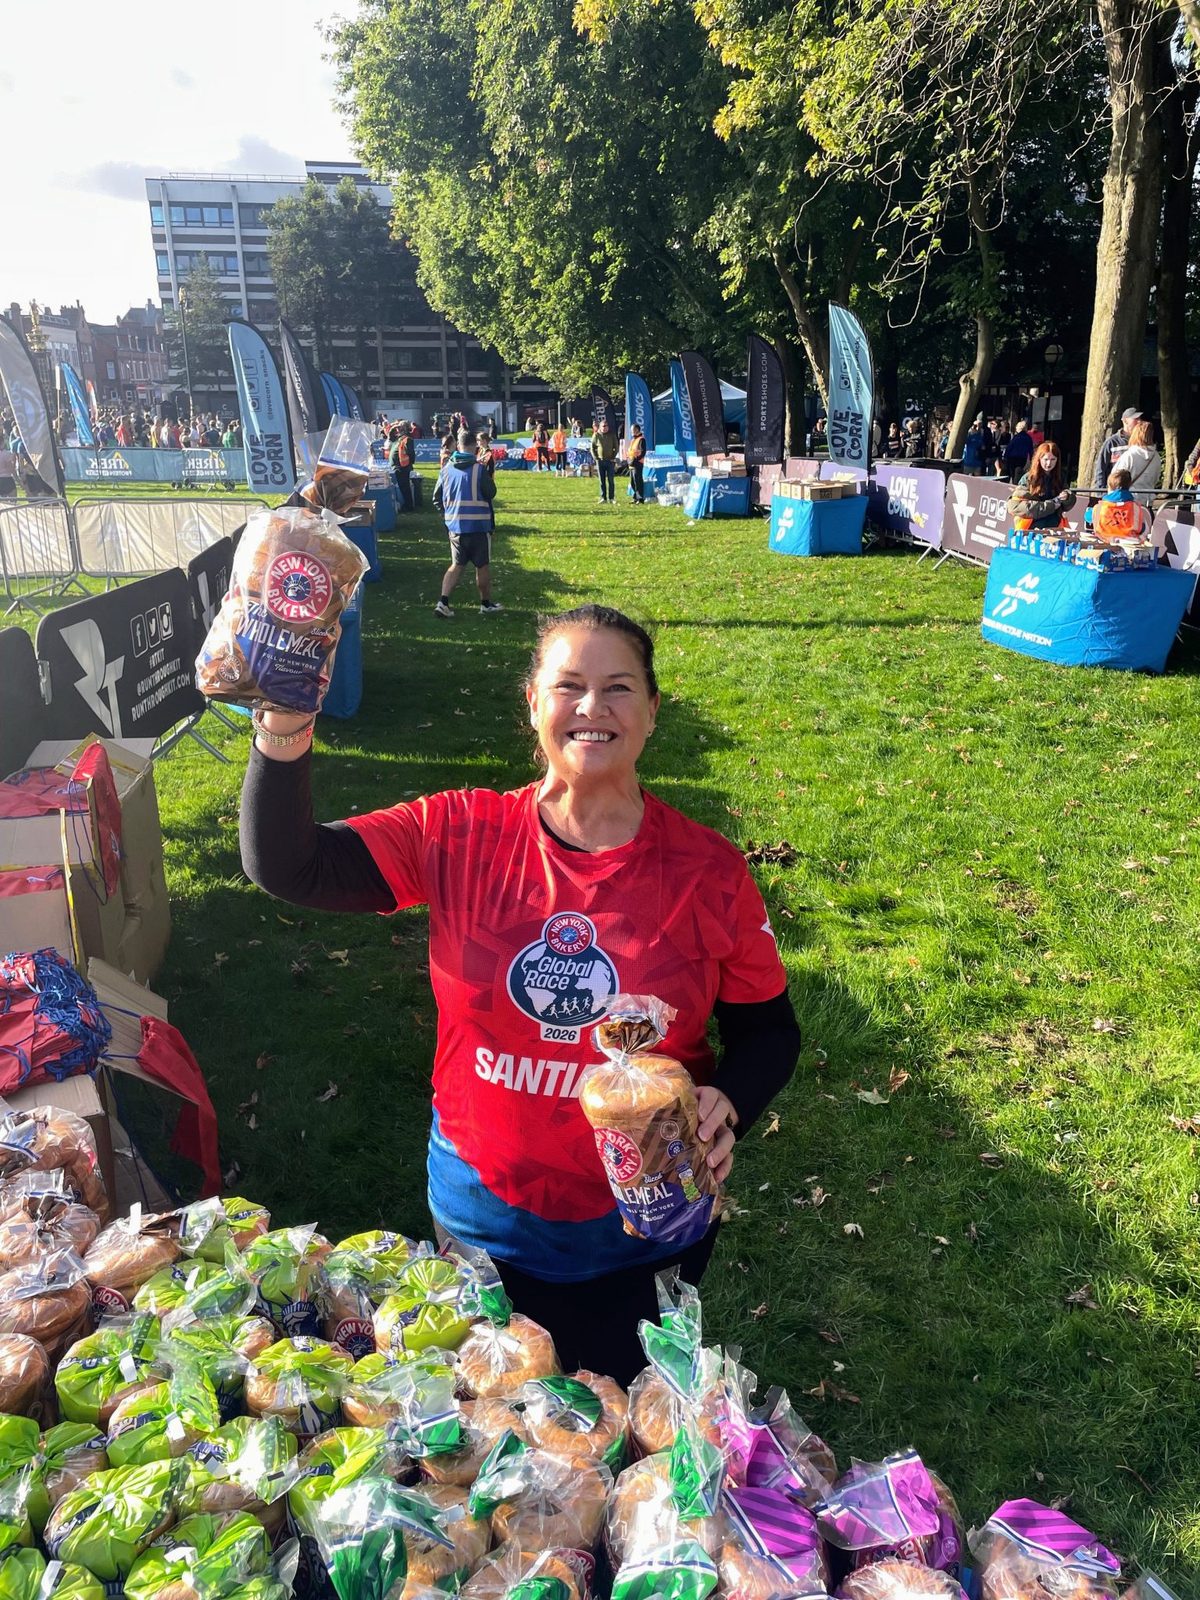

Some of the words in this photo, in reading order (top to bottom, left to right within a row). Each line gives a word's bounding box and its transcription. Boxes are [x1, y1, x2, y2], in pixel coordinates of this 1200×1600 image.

[760, 352, 768, 431] SPORTSSHOES.COM
[271, 557, 301, 580] NEW
[303, 558, 328, 596] YORK
[267, 588, 317, 618] BAKERY
[235, 615, 321, 659] WHOLEMEAL
[262, 652, 277, 661] FULL
[301, 662, 317, 671] YORK
[131, 671, 191, 722] RUNTHROUGHKIT.COM
[551, 917, 569, 934] NEW
[569, 917, 589, 937] YORK
[550, 937, 585, 953] BAKERY
[537, 956, 593, 978] Global
[523, 969, 570, 991] Race
[544, 1027, 577, 1041] 2026
[611, 1182, 673, 1205] LEMEAL
[337, 1322, 356, 1344] NEW
[358, 1322, 375, 1338] YO
